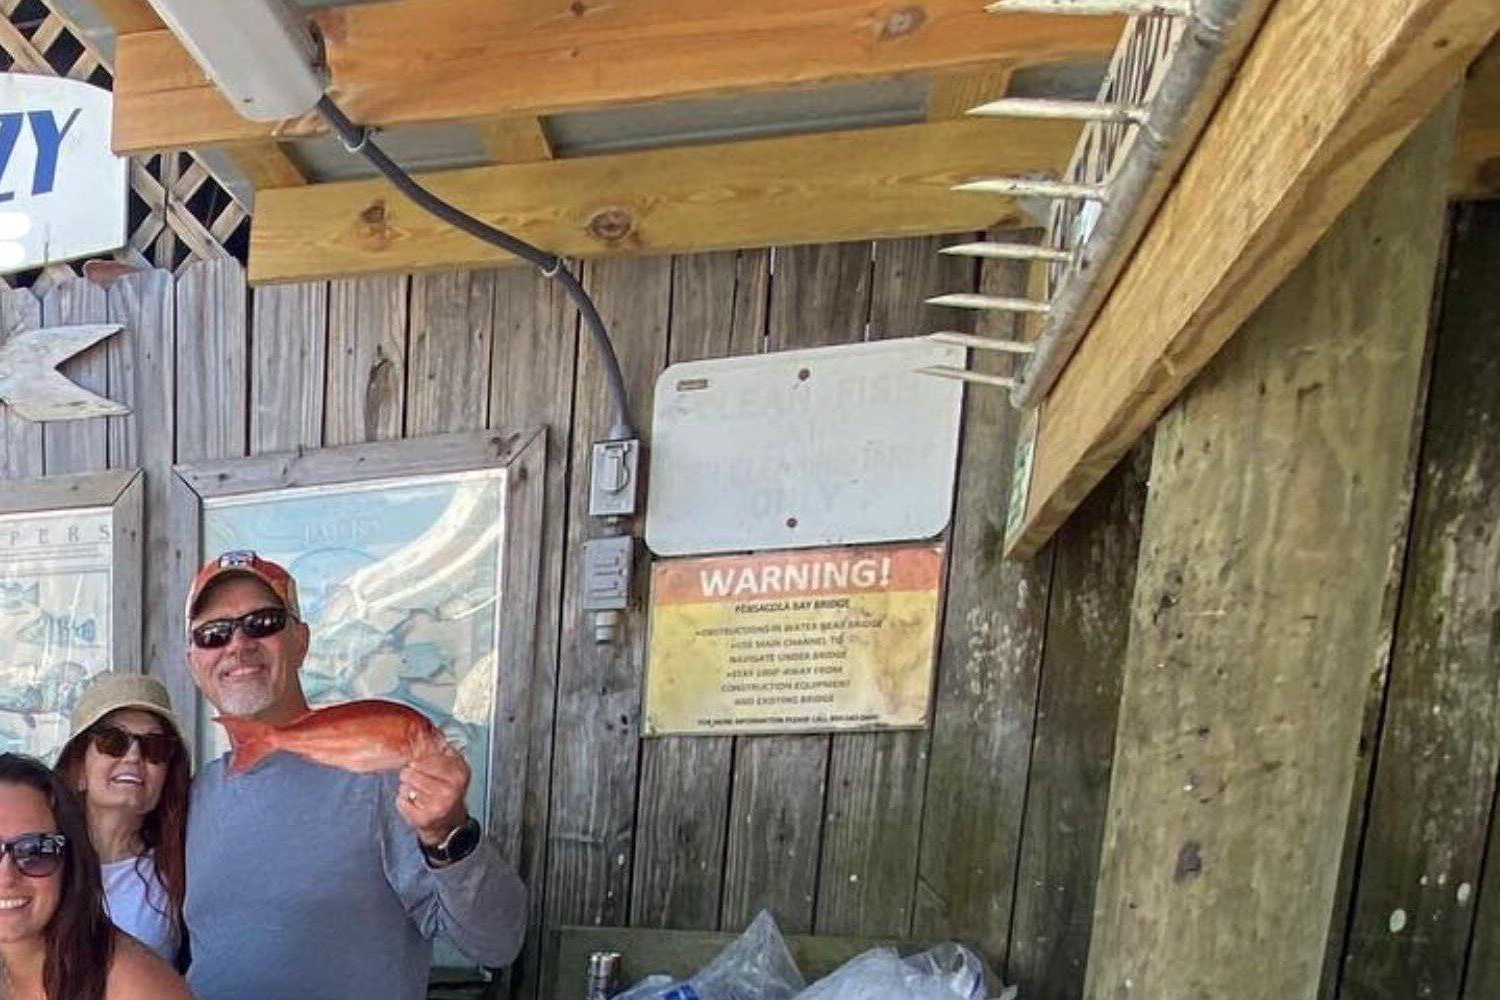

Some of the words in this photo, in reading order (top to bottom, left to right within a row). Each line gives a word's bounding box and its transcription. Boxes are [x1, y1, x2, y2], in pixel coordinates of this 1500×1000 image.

[699, 557, 892, 597] WARNING!
[734, 601, 790, 614] PENSACOLA
[792, 600, 812, 611] BAY
[814, 598, 850, 609] BRIDGE
